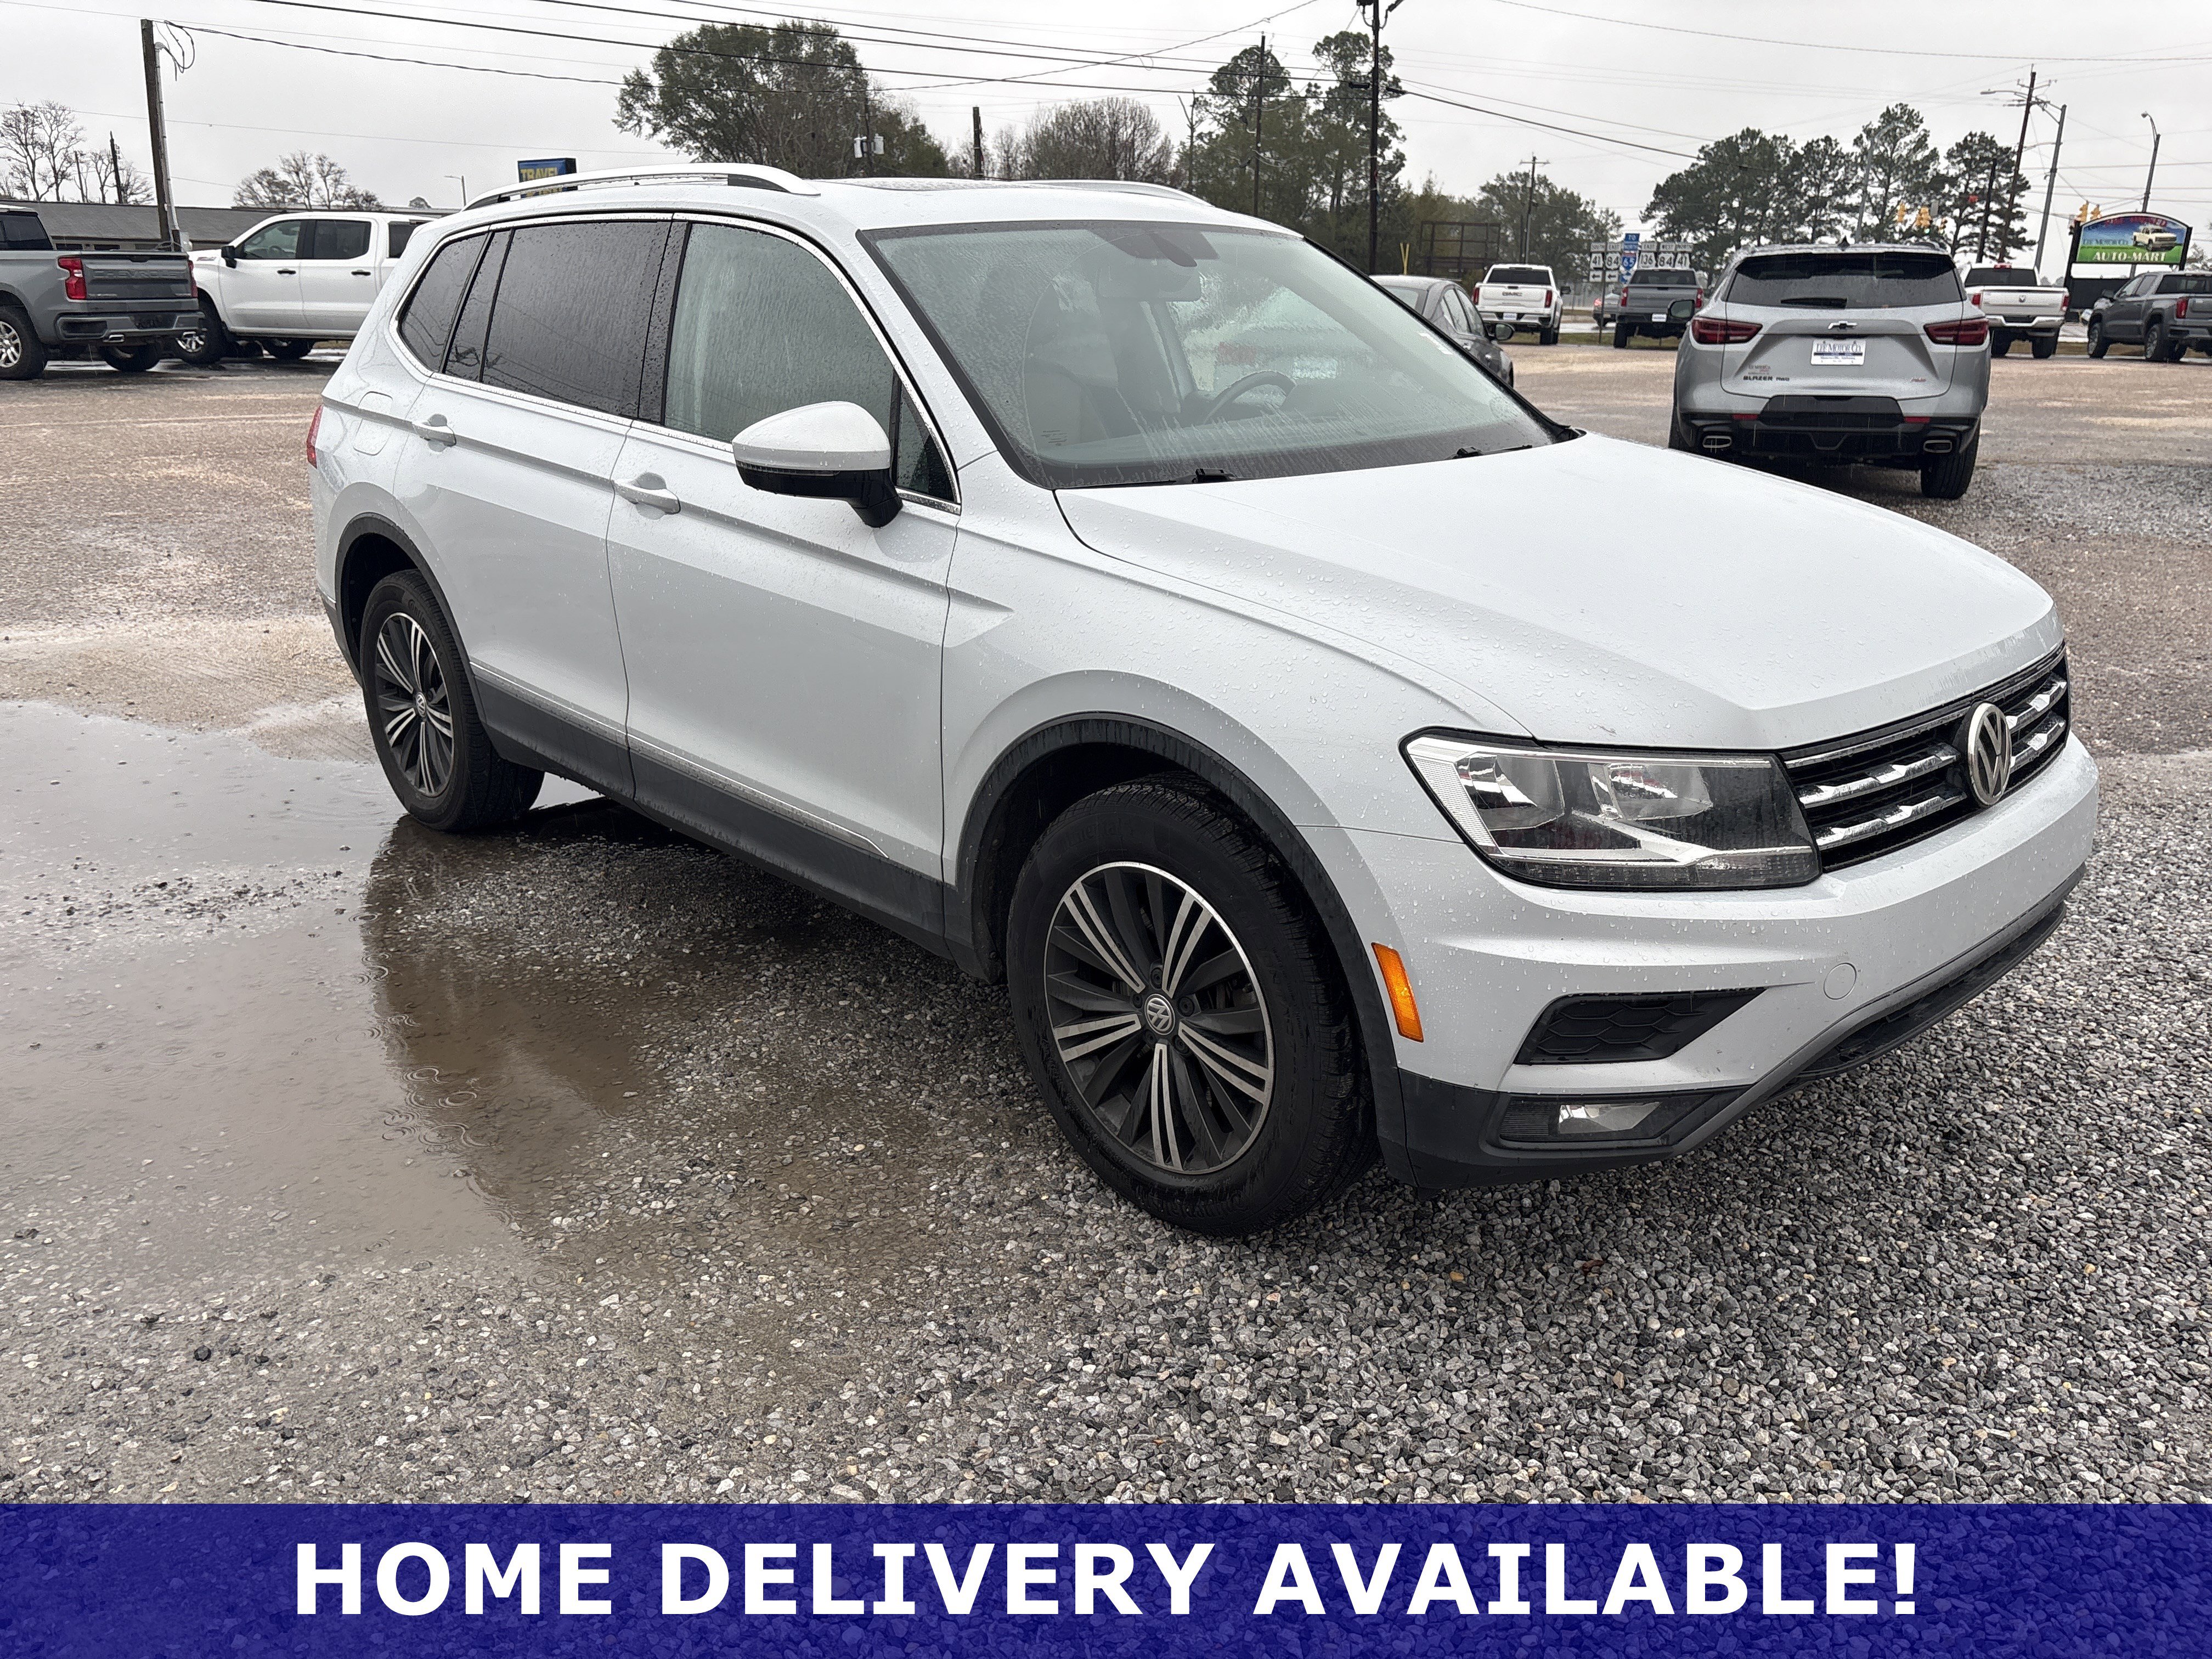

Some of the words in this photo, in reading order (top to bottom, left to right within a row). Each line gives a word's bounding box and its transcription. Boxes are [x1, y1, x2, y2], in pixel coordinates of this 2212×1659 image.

[1592, 256, 1601, 265] 41
[1606, 255, 1619, 266] 84
[1640, 252, 1653, 264] 136
[1658, 256, 1672, 267] 84
[1678, 254, 1687, 264] 41
[2093, 251, 2166, 262] AUTO-MART
[1623, 258, 1635, 267] 65
